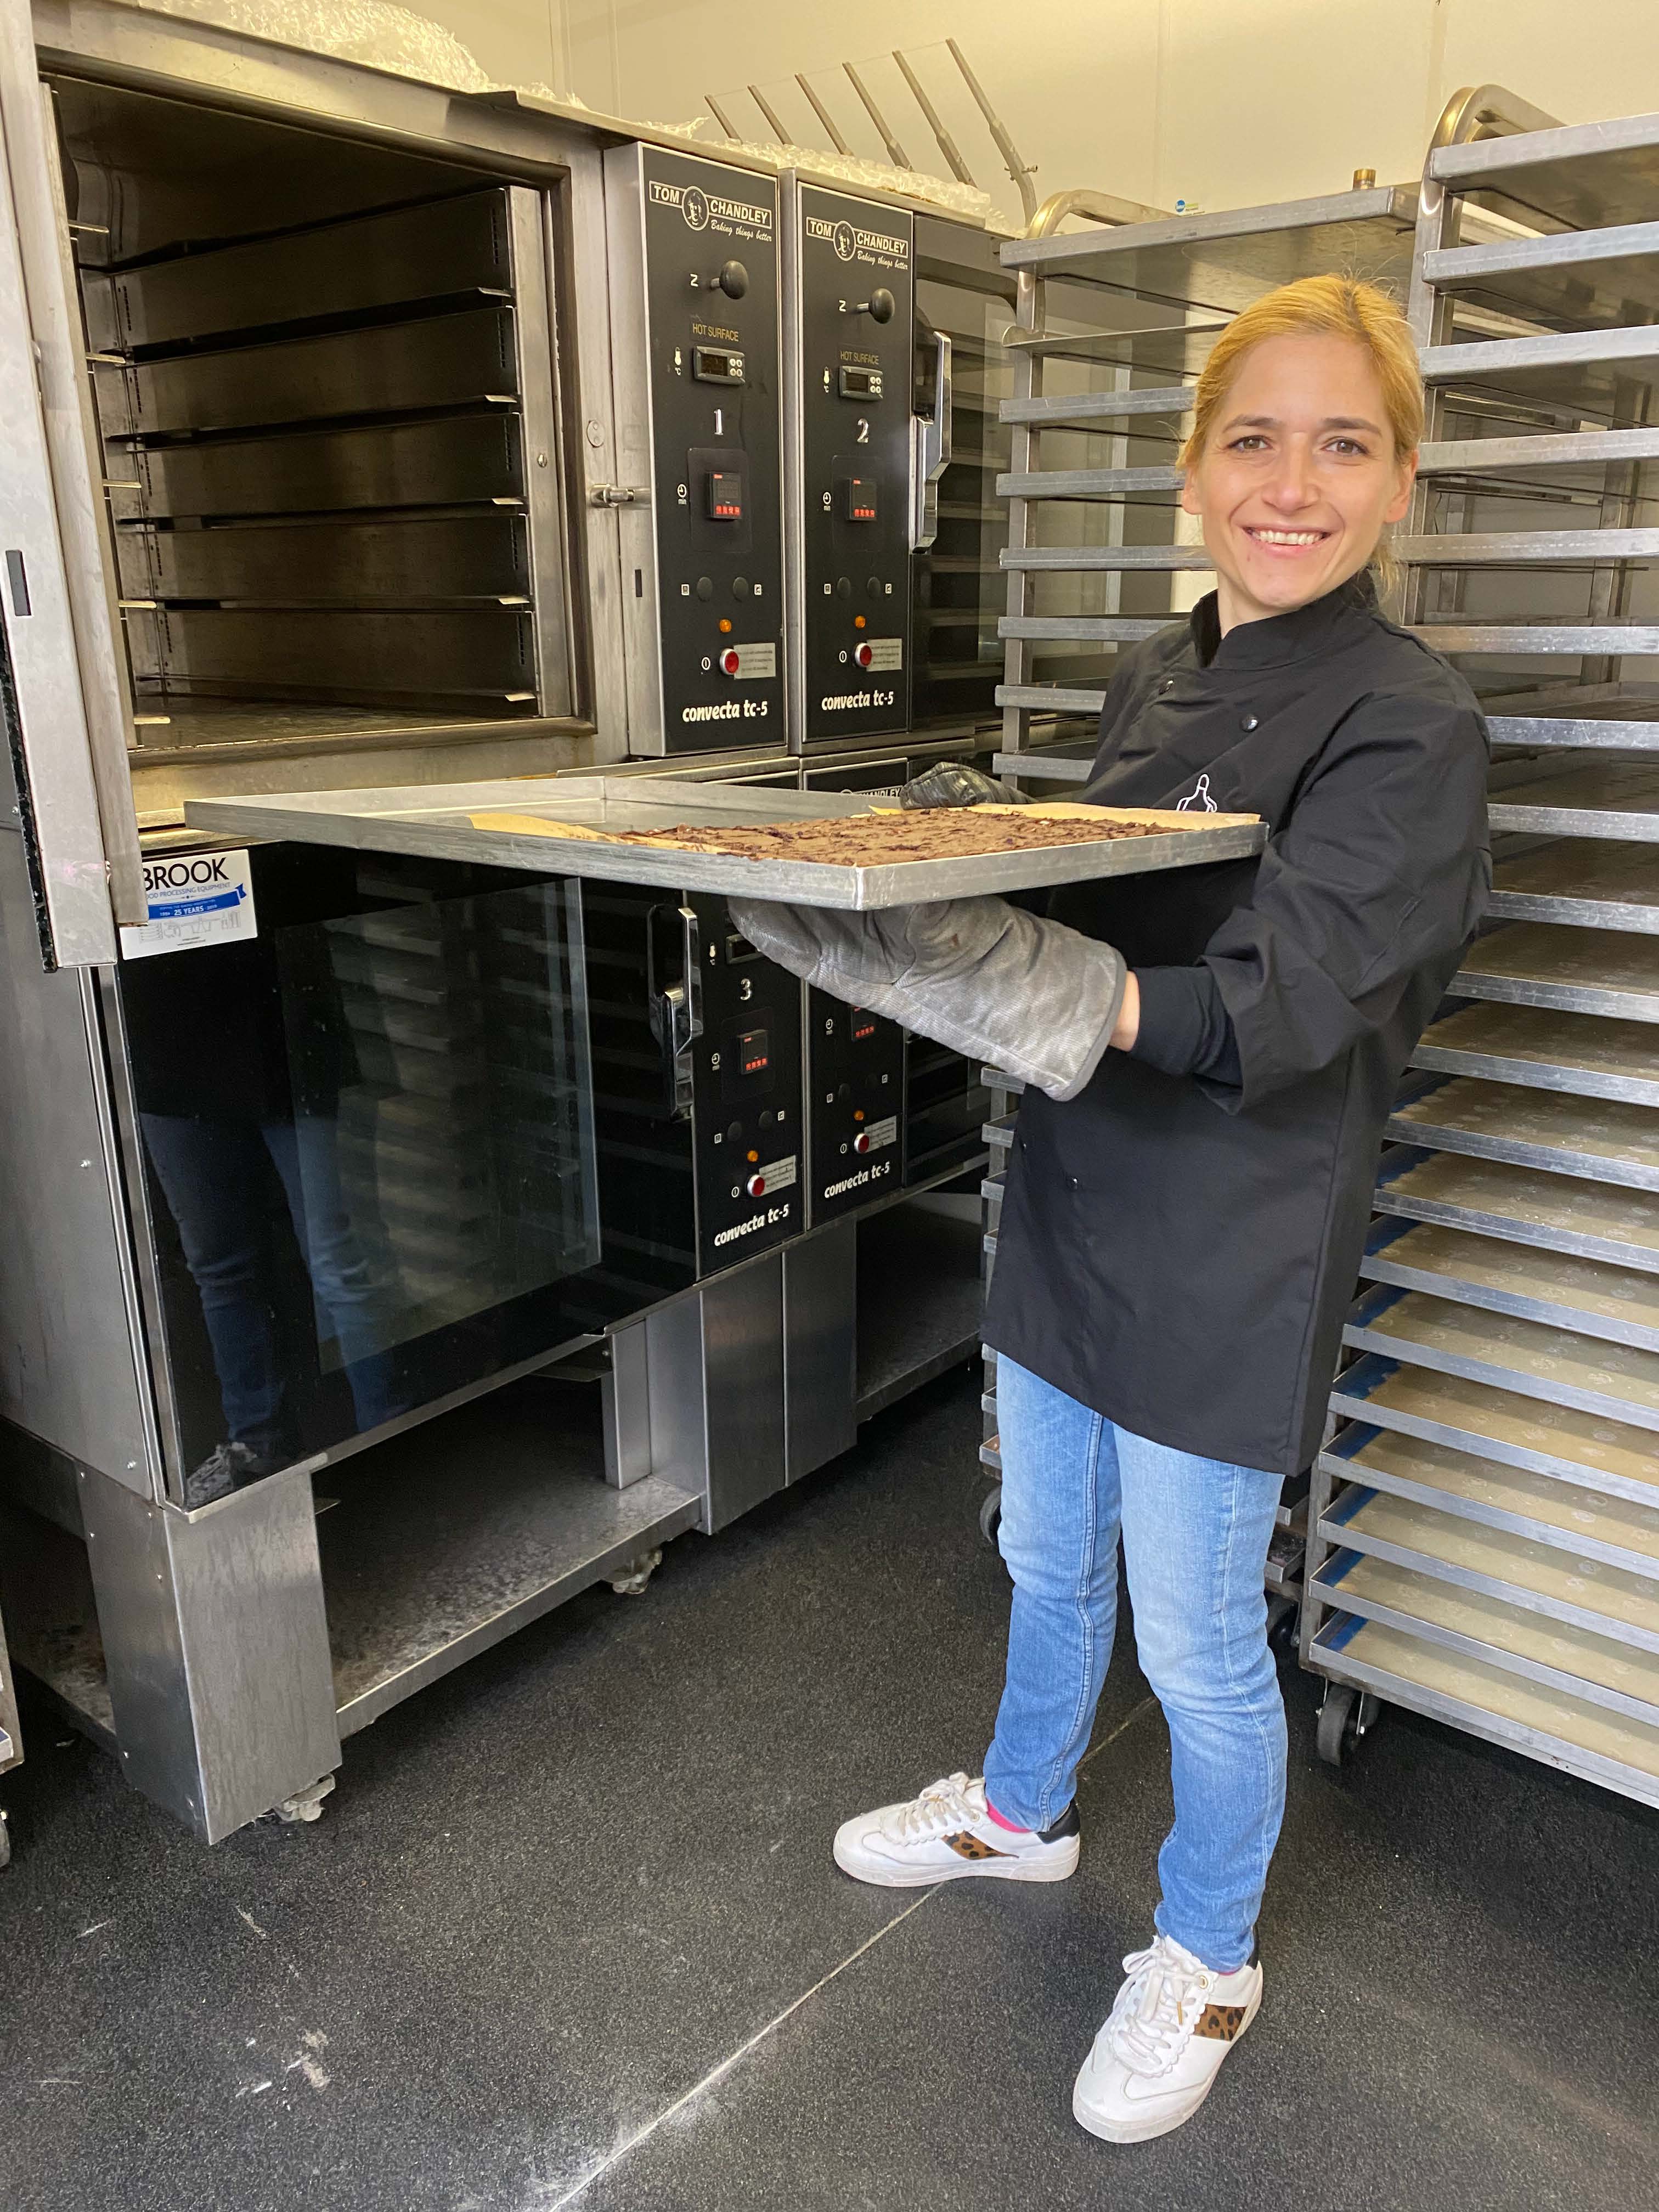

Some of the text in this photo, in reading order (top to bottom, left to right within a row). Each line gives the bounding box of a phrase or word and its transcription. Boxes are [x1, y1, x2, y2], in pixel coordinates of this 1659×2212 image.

[654, 185, 768, 224] TOM CHANDLEY
[710, 219, 772, 242] Baking things better
[810, 221, 905, 254] TOM CHANDLEY
[857, 250, 909, 270] Baking things better
[692, 323, 739, 342] HOT SURFACE
[840, 351, 879, 365] HOT SURFACE
[714, 408, 724, 436] 1
[857, 418, 870, 443] 2
[682, 699, 768, 723] convecta tc-5
[822, 690, 894, 710] convecta tc-5
[143, 857, 230, 891] BROOK
[160, 887, 197, 897] PROCESSING
[198, 882, 231, 893] EQUIPMENT
[183, 905, 205, 915] YEARS
[740, 978, 752, 1001] 3
[825, 1161, 890, 1198] convecta tc-5
[714, 1203, 790, 1246] convecta tc-5
